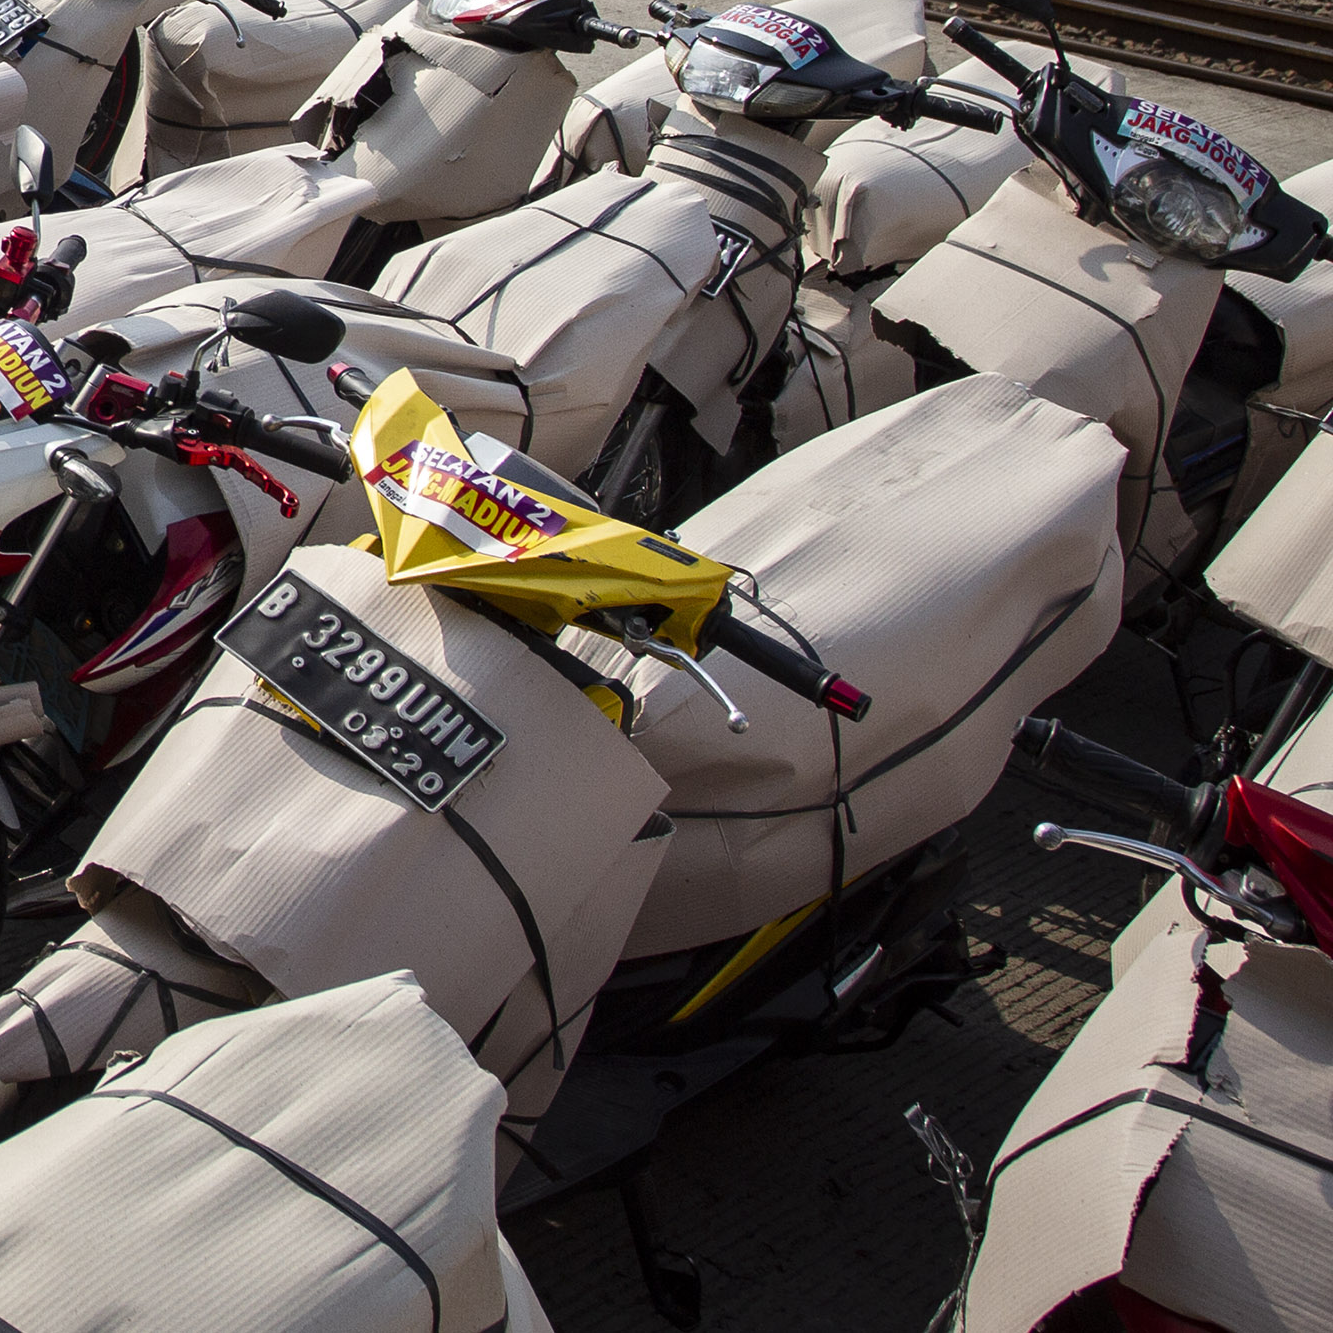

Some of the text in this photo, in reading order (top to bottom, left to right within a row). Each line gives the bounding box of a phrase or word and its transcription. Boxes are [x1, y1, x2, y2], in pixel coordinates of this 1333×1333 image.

[810, 32, 824, 48] 2
[1126, 112, 1258, 196] JAKG-JOGJA
[1137, 100, 1261, 179] SELATAN 2
[40, 373, 67, 395] 2
[410, 444, 553, 528] SELATAN 2
[256, 581, 491, 769] B 3299UHW
